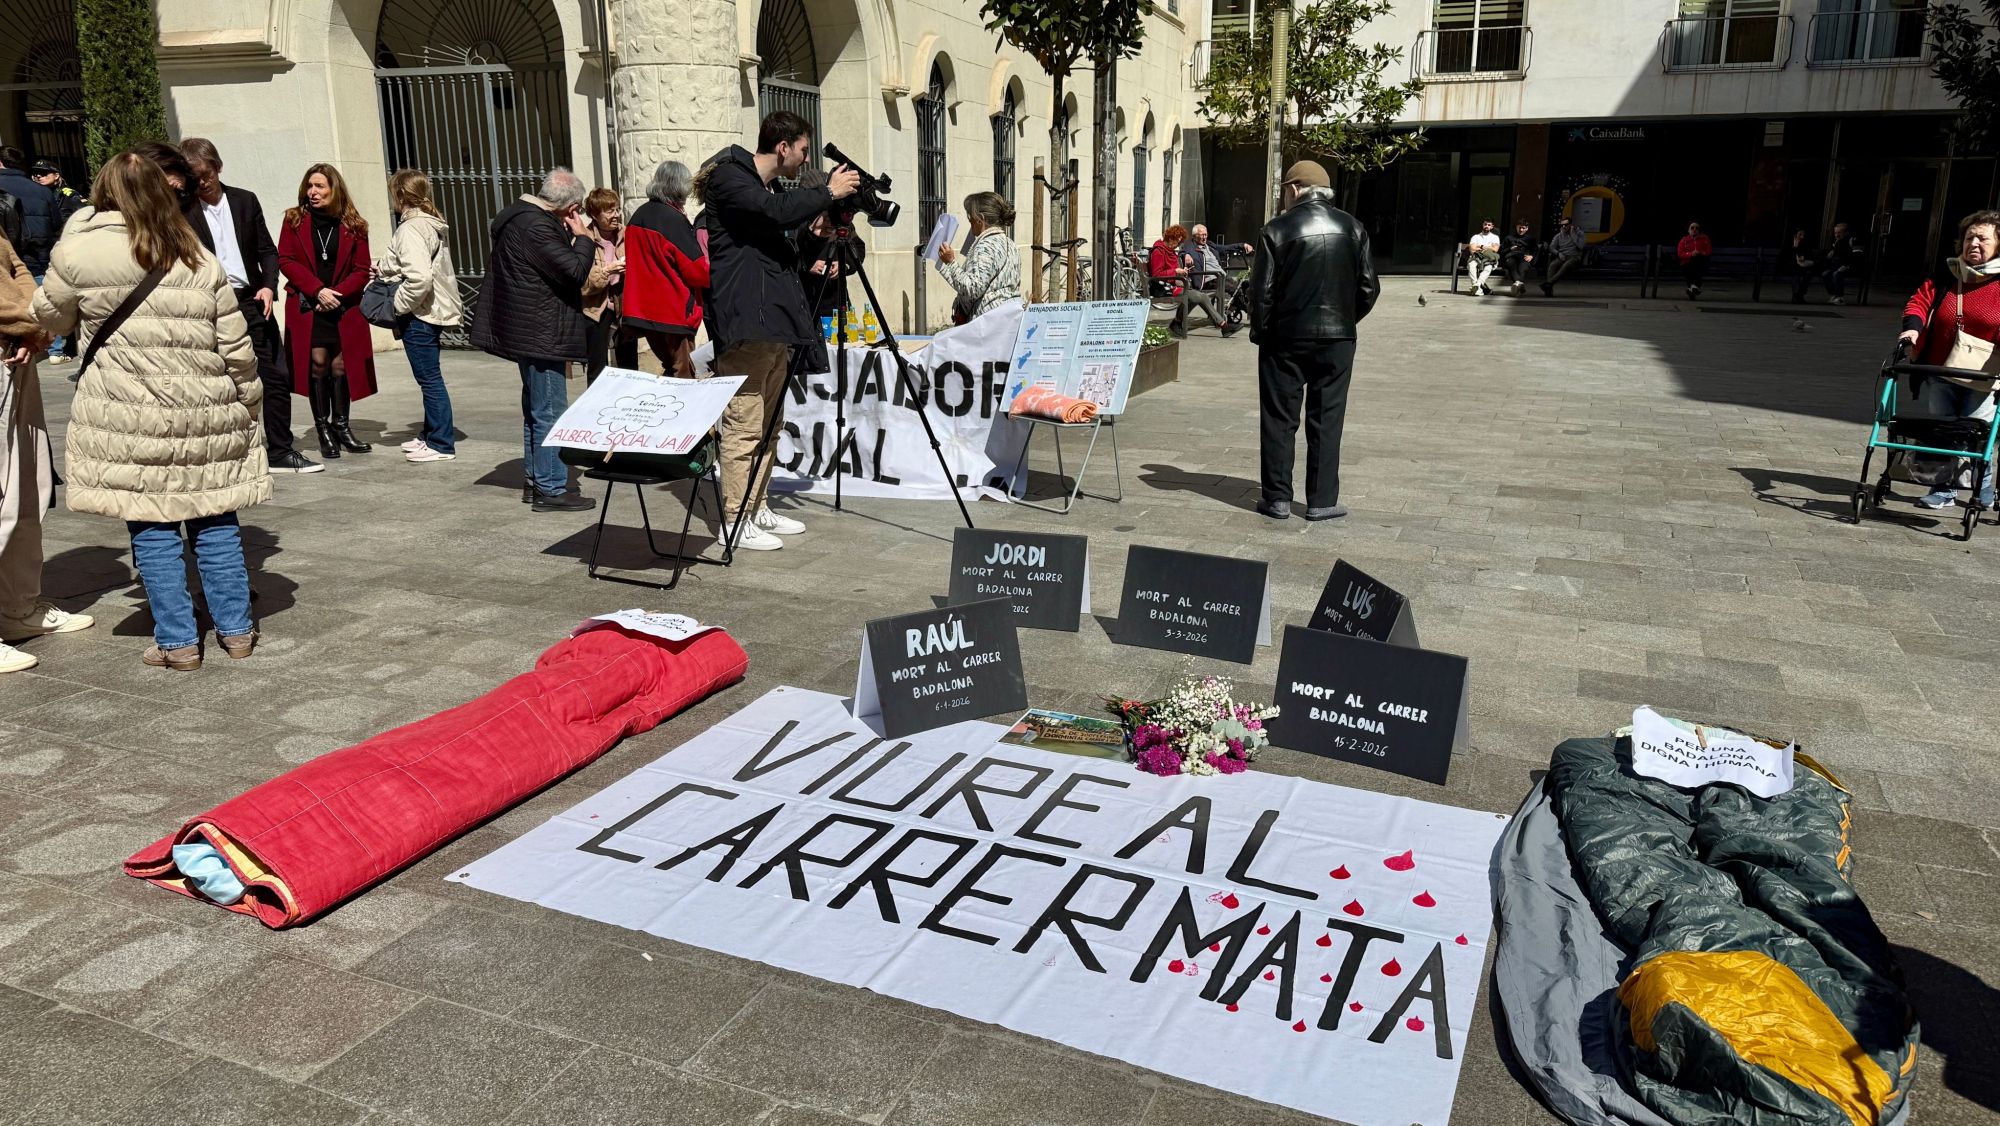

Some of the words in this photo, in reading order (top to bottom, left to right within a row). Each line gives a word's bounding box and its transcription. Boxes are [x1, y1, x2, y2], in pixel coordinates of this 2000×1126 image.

[1590, 126, 1646, 138] CaixaBank
[1028, 306, 1059, 314] MENJADORS
[550, 428, 601, 446] ALBERG
[603, 431, 650, 448] SOCIAL
[984, 542, 1046, 568] JORDI
[962, 566, 994, 577] MORT
[1003, 569, 1016, 579] AL
[1028, 572, 1063, 584] CARRER
[977, 583, 1033, 597] BADALONA
[1343, 581, 1376, 619] LUÍS
[1136, 588, 1170, 603] MORT
[1178, 596, 1191, 608] AL
[1202, 600, 1241, 616] CARRER
[1150, 608, 1208, 629] BADALONA
[1324, 606, 1343, 623] MORT
[1344, 620, 1353, 633] AL
[906, 613, 974, 658] RAÚL
[1164, 628, 1208, 643] 3-3-2026
[891, 664, 926, 683] MORT
[936, 660, 952, 674] AL
[962, 651, 1002, 670] CARRER
[912, 676, 974, 699] BADALONA
[935, 698, 971, 712] 6-1-2026
[1292, 681, 1335, 700] MORT
[1345, 694, 1364, 709] AL
[1378, 701, 1428, 724] CARRER
[1309, 707, 1385, 736] BADALONA
[1334, 736, 1389, 758] 15-2-2026
[1664, 742, 1756, 762] BADALONA
[1674, 737, 1706, 753] PER
[1640, 742, 1690, 768] DIGNA
[1704, 759, 1777, 778] HUMANA
[732, 720, 1131, 849] VIURE
[1114, 796, 1318, 900] AL
[576, 783, 1155, 973] CARRER
[1130, 886, 1453, 1060] MATA
